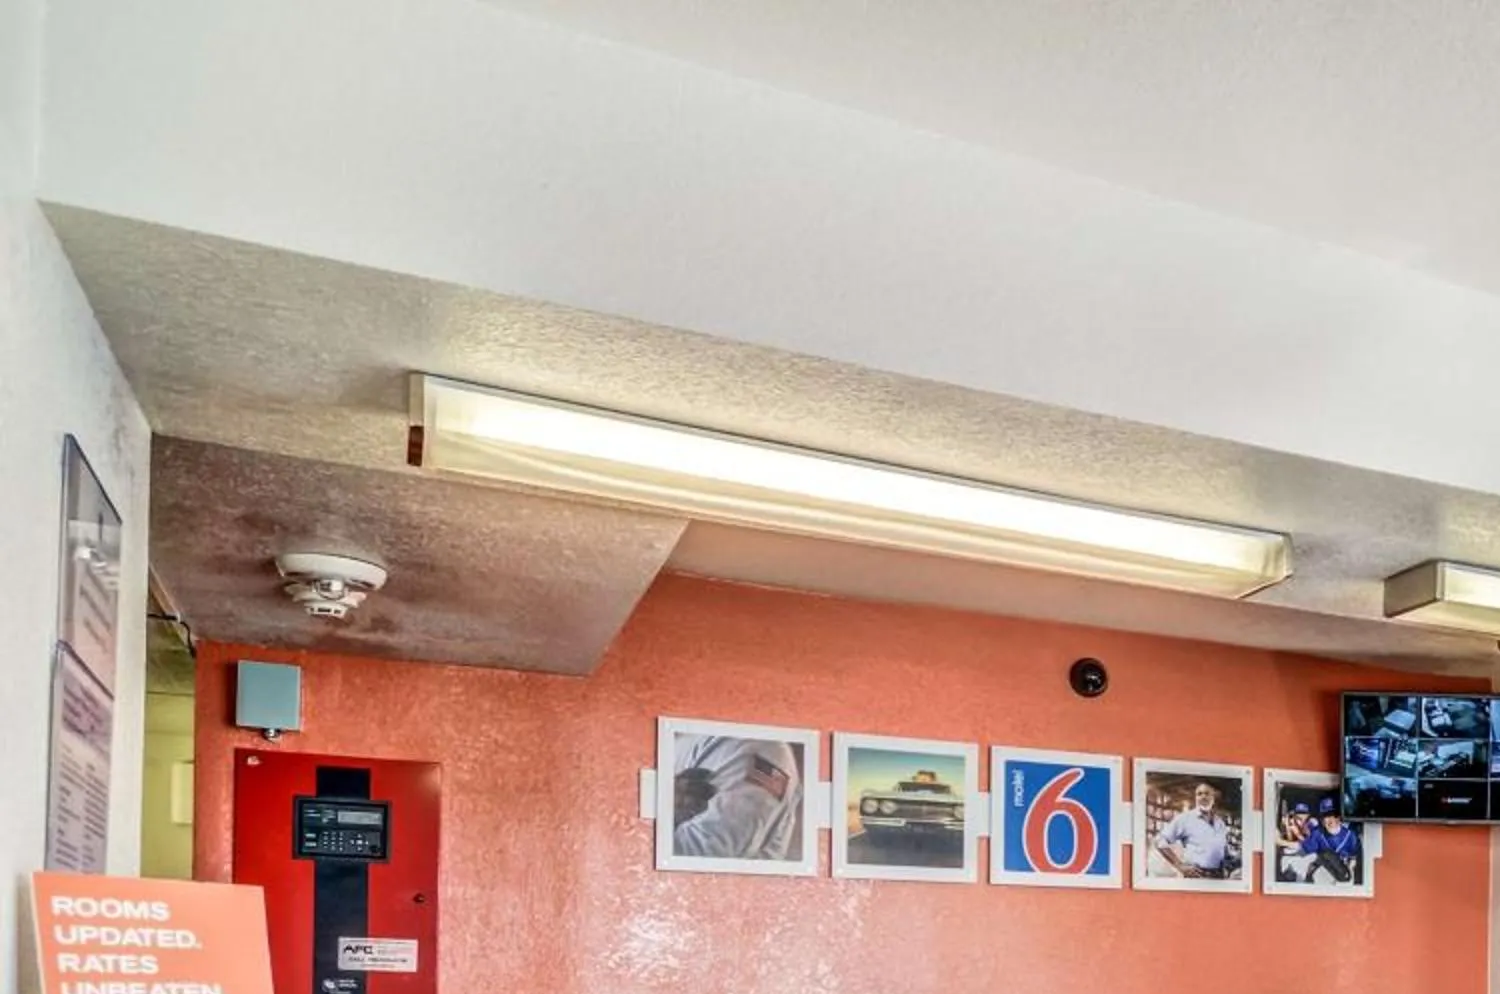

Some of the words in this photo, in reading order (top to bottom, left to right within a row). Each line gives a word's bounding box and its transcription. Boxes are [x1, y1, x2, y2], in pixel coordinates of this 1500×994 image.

[1012, 769, 1025, 807] motel
[1022, 767, 1099, 875] 6
[51, 895, 170, 922] ROOMS
[54, 924, 202, 950] UPDATED.
[57, 953, 159, 975] RATES
